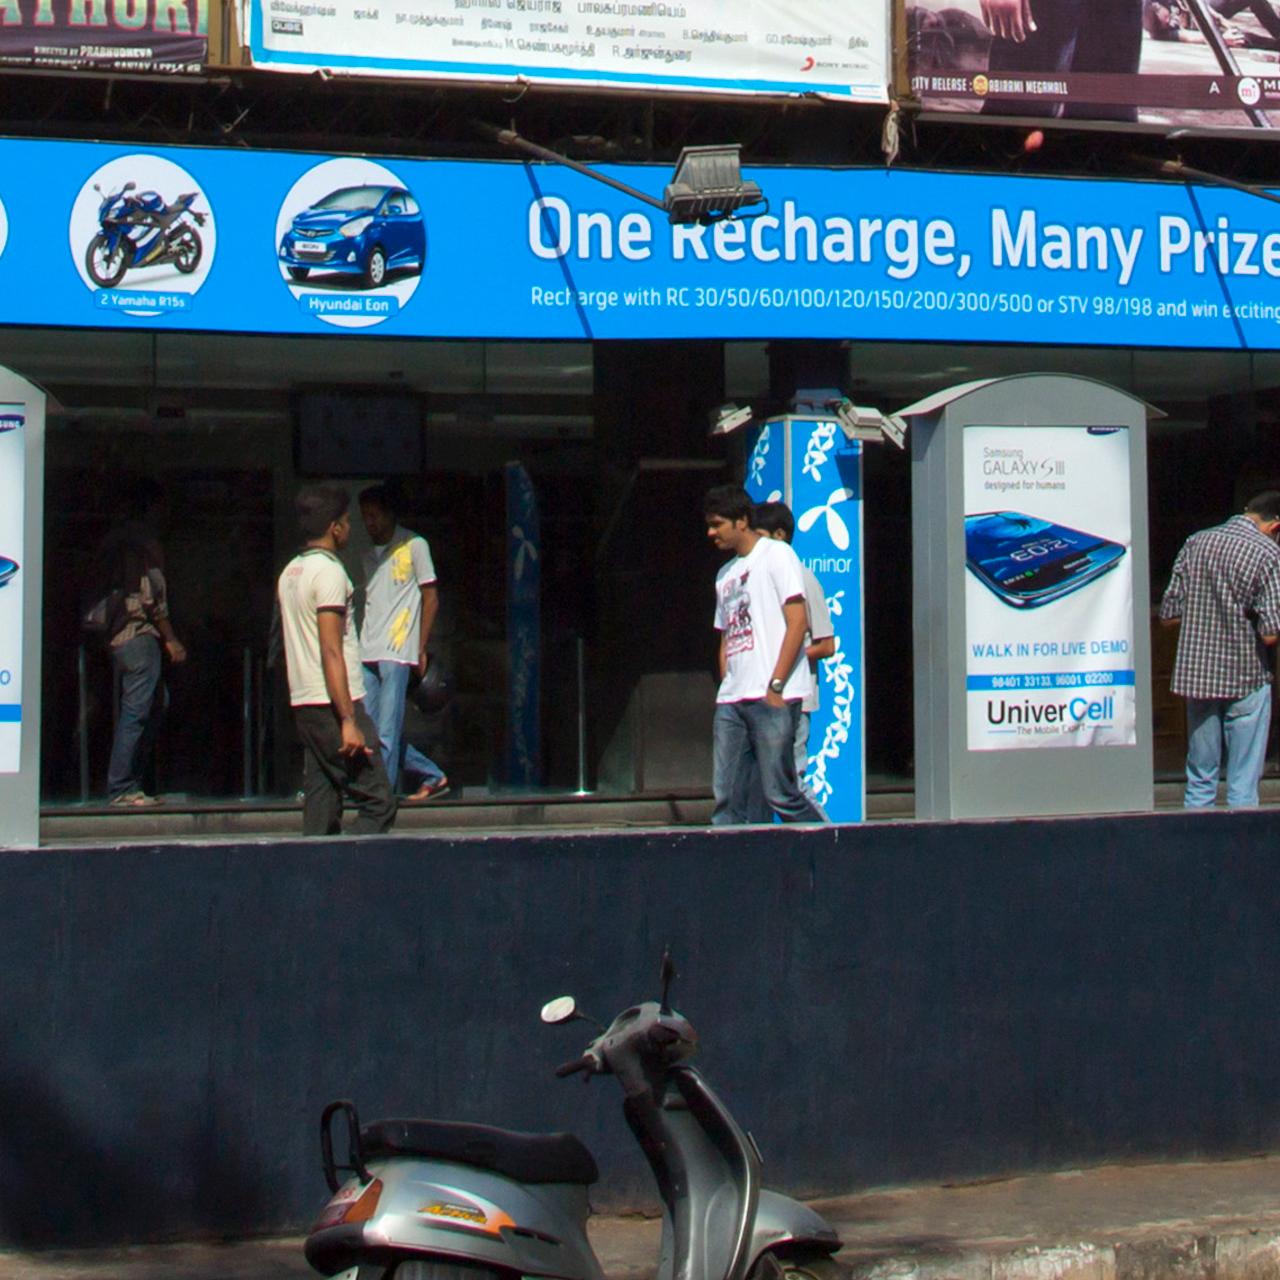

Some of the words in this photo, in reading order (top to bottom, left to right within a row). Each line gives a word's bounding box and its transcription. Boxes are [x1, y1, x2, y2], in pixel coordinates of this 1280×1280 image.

[931, 77, 968, 92] RELEASE
[1208, 81, 1221, 95] A
[528, 195, 652, 261] One
[673, 200, 971, 280] Recharge,
[989, 207, 1135, 285] Many
[100, 293, 110, 306] 2
[111, 294, 157, 308] Yamaha
[158, 295, 185, 309] R15s
[308, 295, 363, 313] Hyundai
[365, 298, 389, 312] Eon
[531, 286, 618, 311] Recharge
[623, 286, 662, 307] with
[666, 286, 691, 308] RC
[694, 287, 1033, 313] 30/50/60/100/120/150/200/300/500
[1037, 297, 1055, 314] or
[1058, 295, 1089, 315] STV
[1092, 296, 1153, 318] 98/198
[1156, 299, 1188, 317] and
[1191, 301, 1218, 319] win
[983, 446, 1024, 461] Samsung
[982, 459, 1037, 476] GALAXY
[984, 479, 1020, 493] designed
[1022, 480, 1035, 491] for
[803, 555, 852, 574] uninor
[972, 643, 1014, 658] WALK
[1016, 643, 1030, 657] IN
[1033, 642, 1058, 657] FOR
[1061, 641, 1087, 656] LIVE
[1090, 640, 1129, 655] DEMO
[987, 695, 1114, 725] UniverCell
